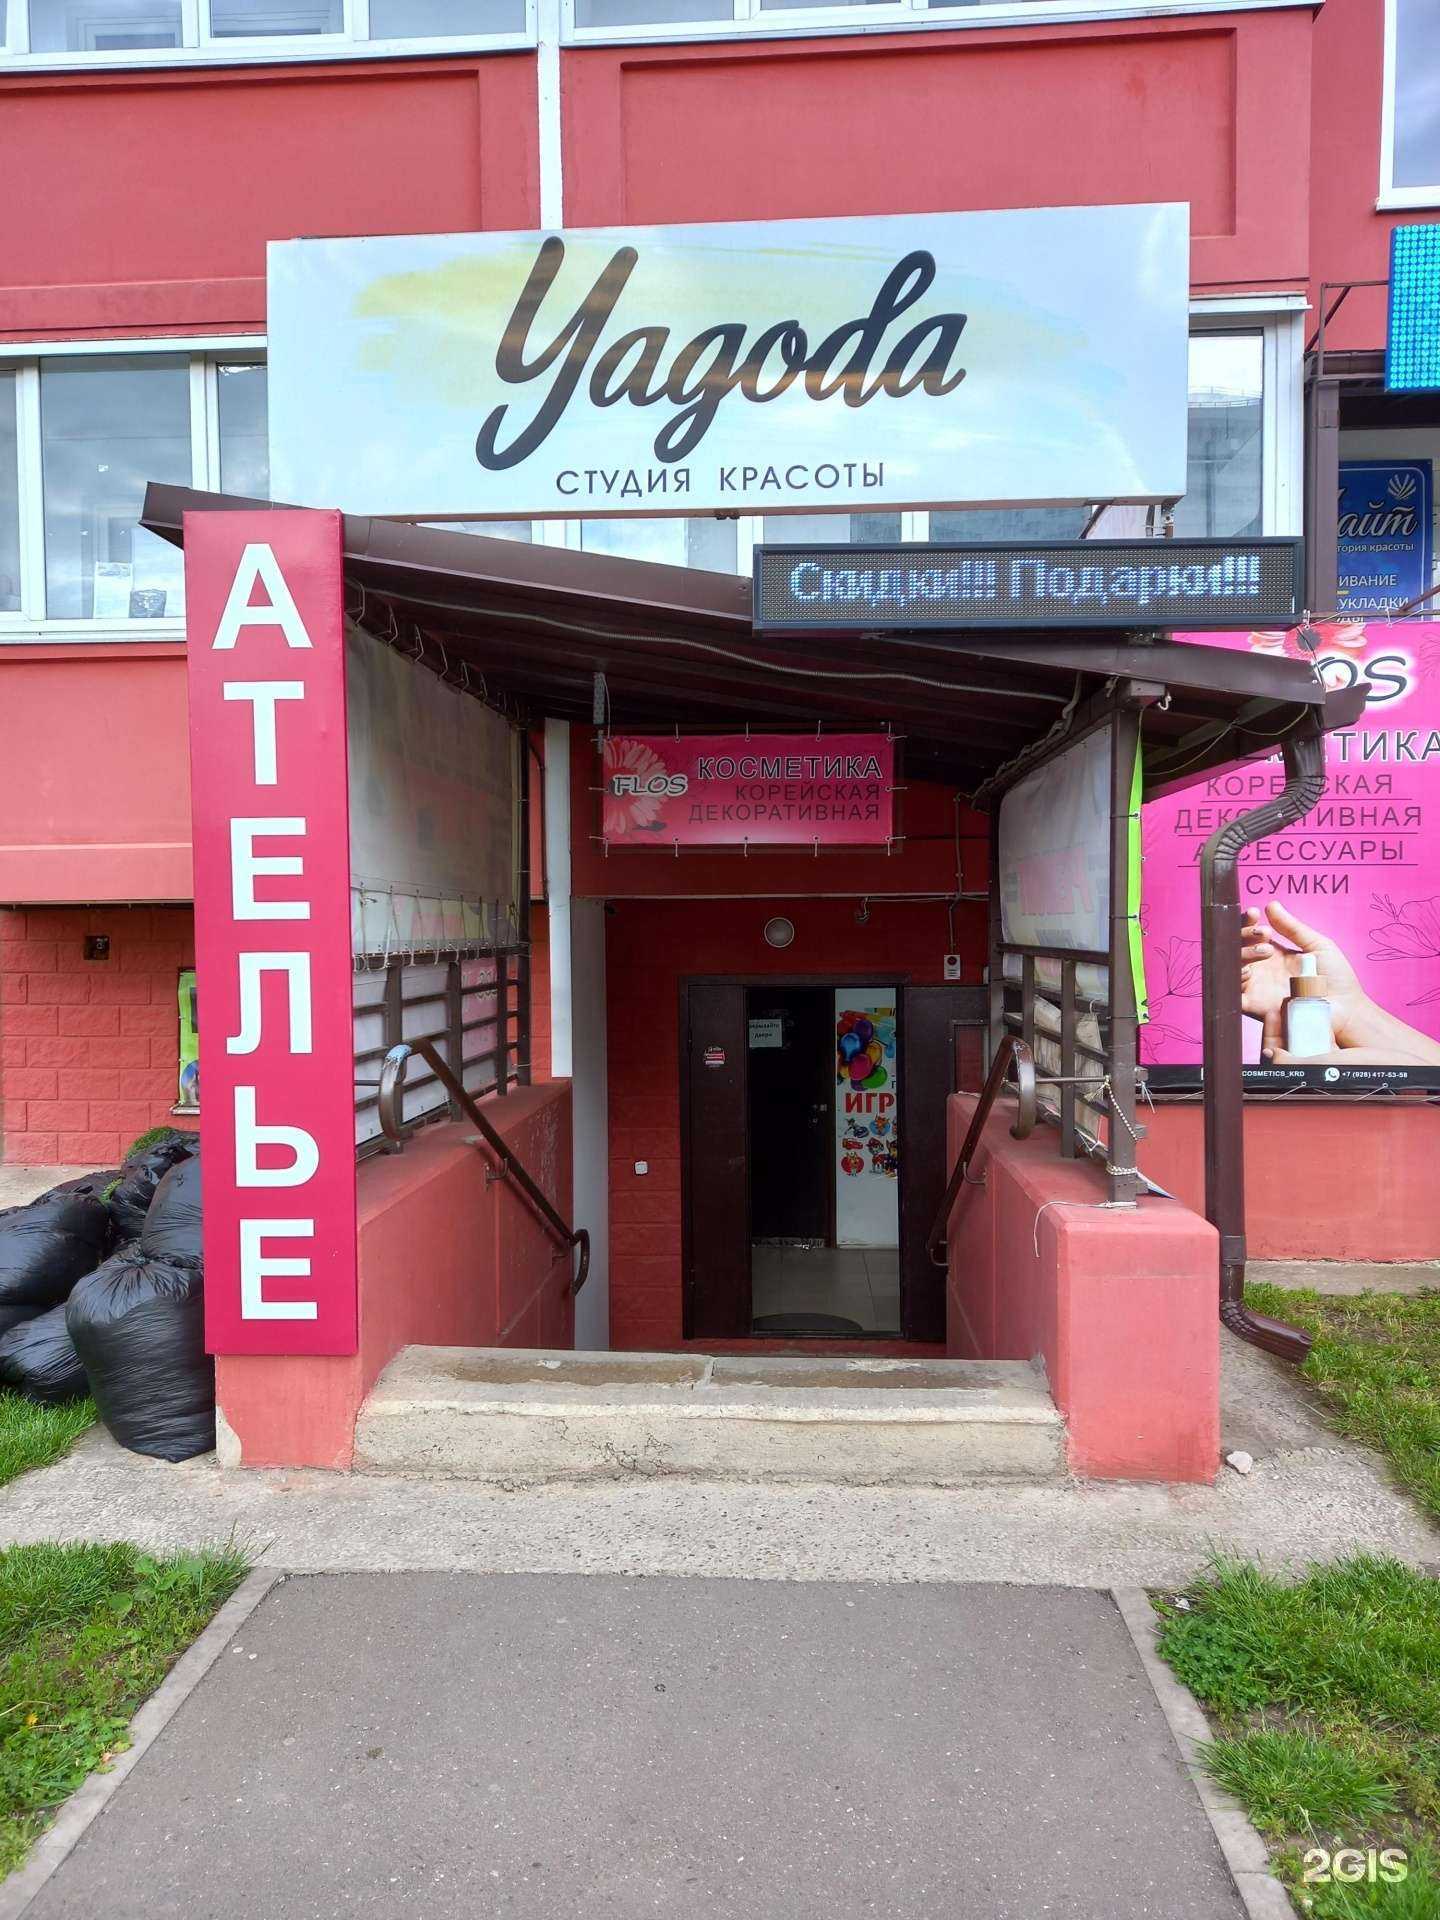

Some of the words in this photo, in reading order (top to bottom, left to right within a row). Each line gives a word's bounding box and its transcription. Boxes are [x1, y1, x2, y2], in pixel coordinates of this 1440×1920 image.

[475, 236, 968, 471] Yagoda
[556, 468, 691, 498] СТУДИЯ
[719, 463, 884, 491] КРАСОТЫ
[1338, 487, 1419, 538] айт
[1337, 545, 1367, 553] тория
[1370, 543, 1414, 553] красоты
[790, 560, 997, 606] Скидки!!!
[1008, 554, 1261, 606] Подарки!!!
[1338, 574, 1397, 587] ИВАНИЕ
[1313, 655, 1408, 702] OS
[697, 755, 883, 779] КОСМЕТИКА
[614, 774, 688, 797] FLOS
[735, 781, 880, 801] КОРЕЙСКАЯ
[1207, 774, 1392, 796] КОРЕКАЯ
[689, 803, 880, 824] ДЕКОРАТИВНАЯ
[1174, 806, 1421, 833] ДЕКИВНАЯ
[1246, 874, 1349, 895] СУМКИ
[212, 542, 321, 1321] АТЕЛЬЕ
[845, 1092, 897, 1114] ИГР
